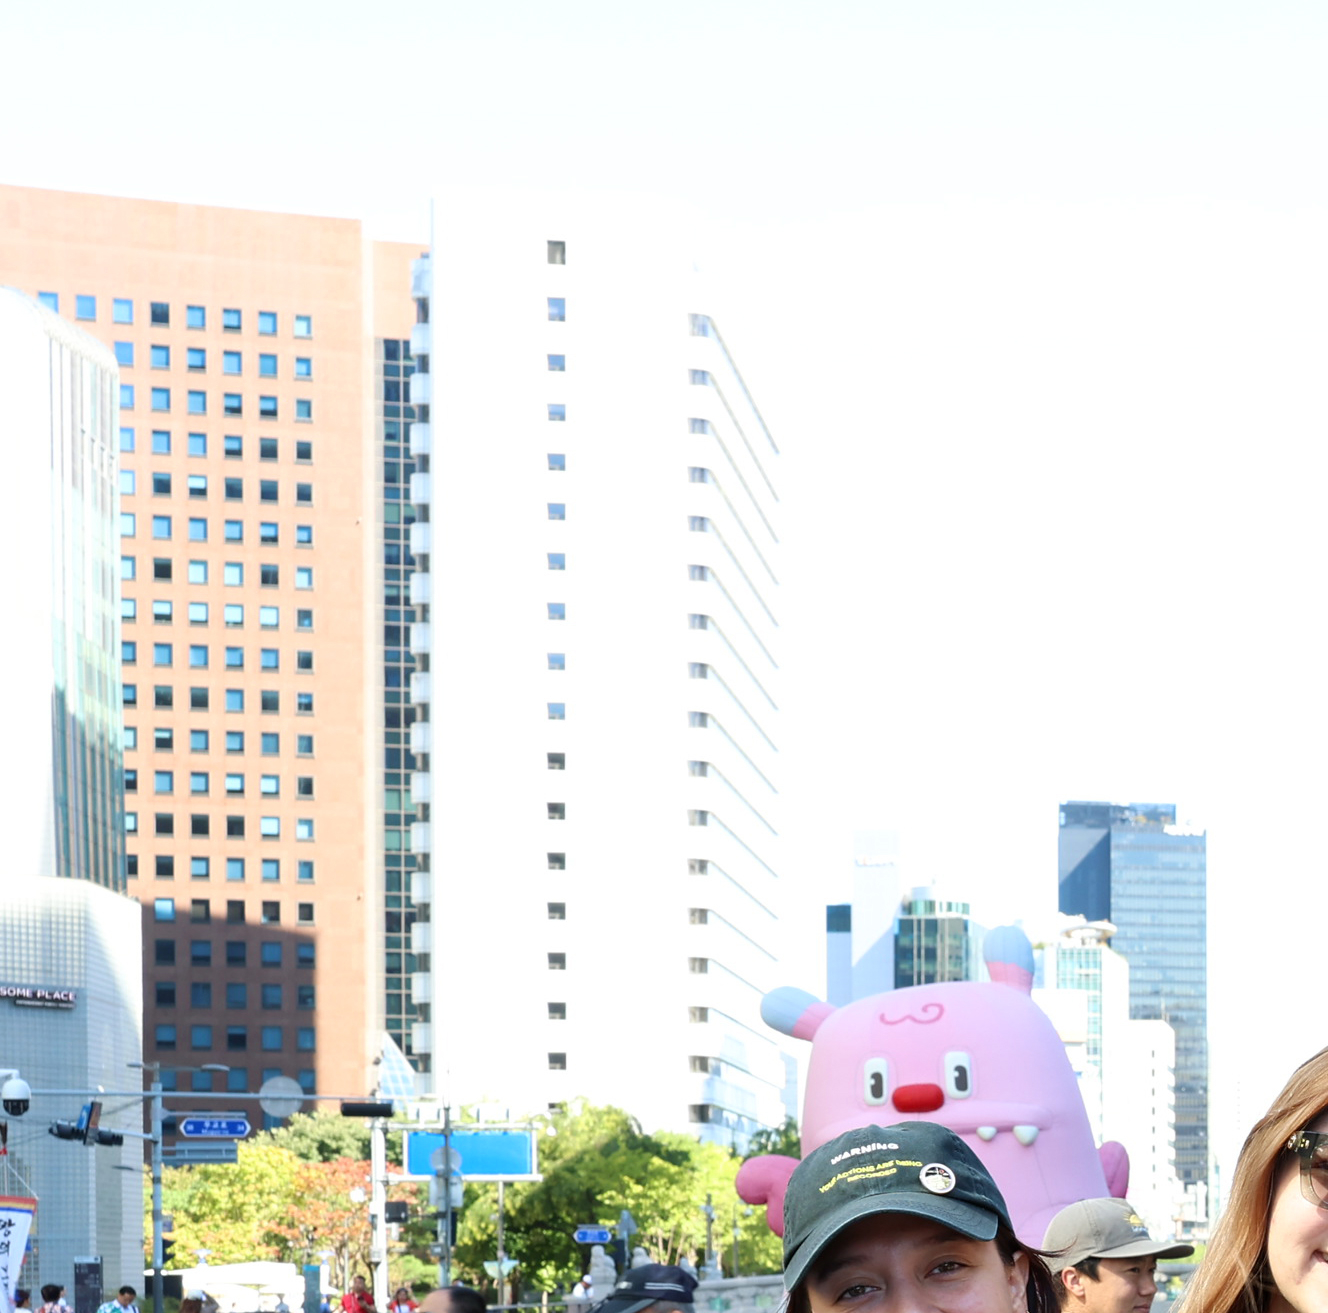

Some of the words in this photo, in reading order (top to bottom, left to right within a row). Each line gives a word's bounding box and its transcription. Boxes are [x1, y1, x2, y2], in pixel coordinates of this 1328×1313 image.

[36, 988, 76, 1001] PLACE
[830, 1142, 900, 1165] WARNING
[836, 1164, 876, 1181] ACTIONS
[875, 1159, 895, 1171] ARE
[846, 1167, 898, 1183] RECORDED
